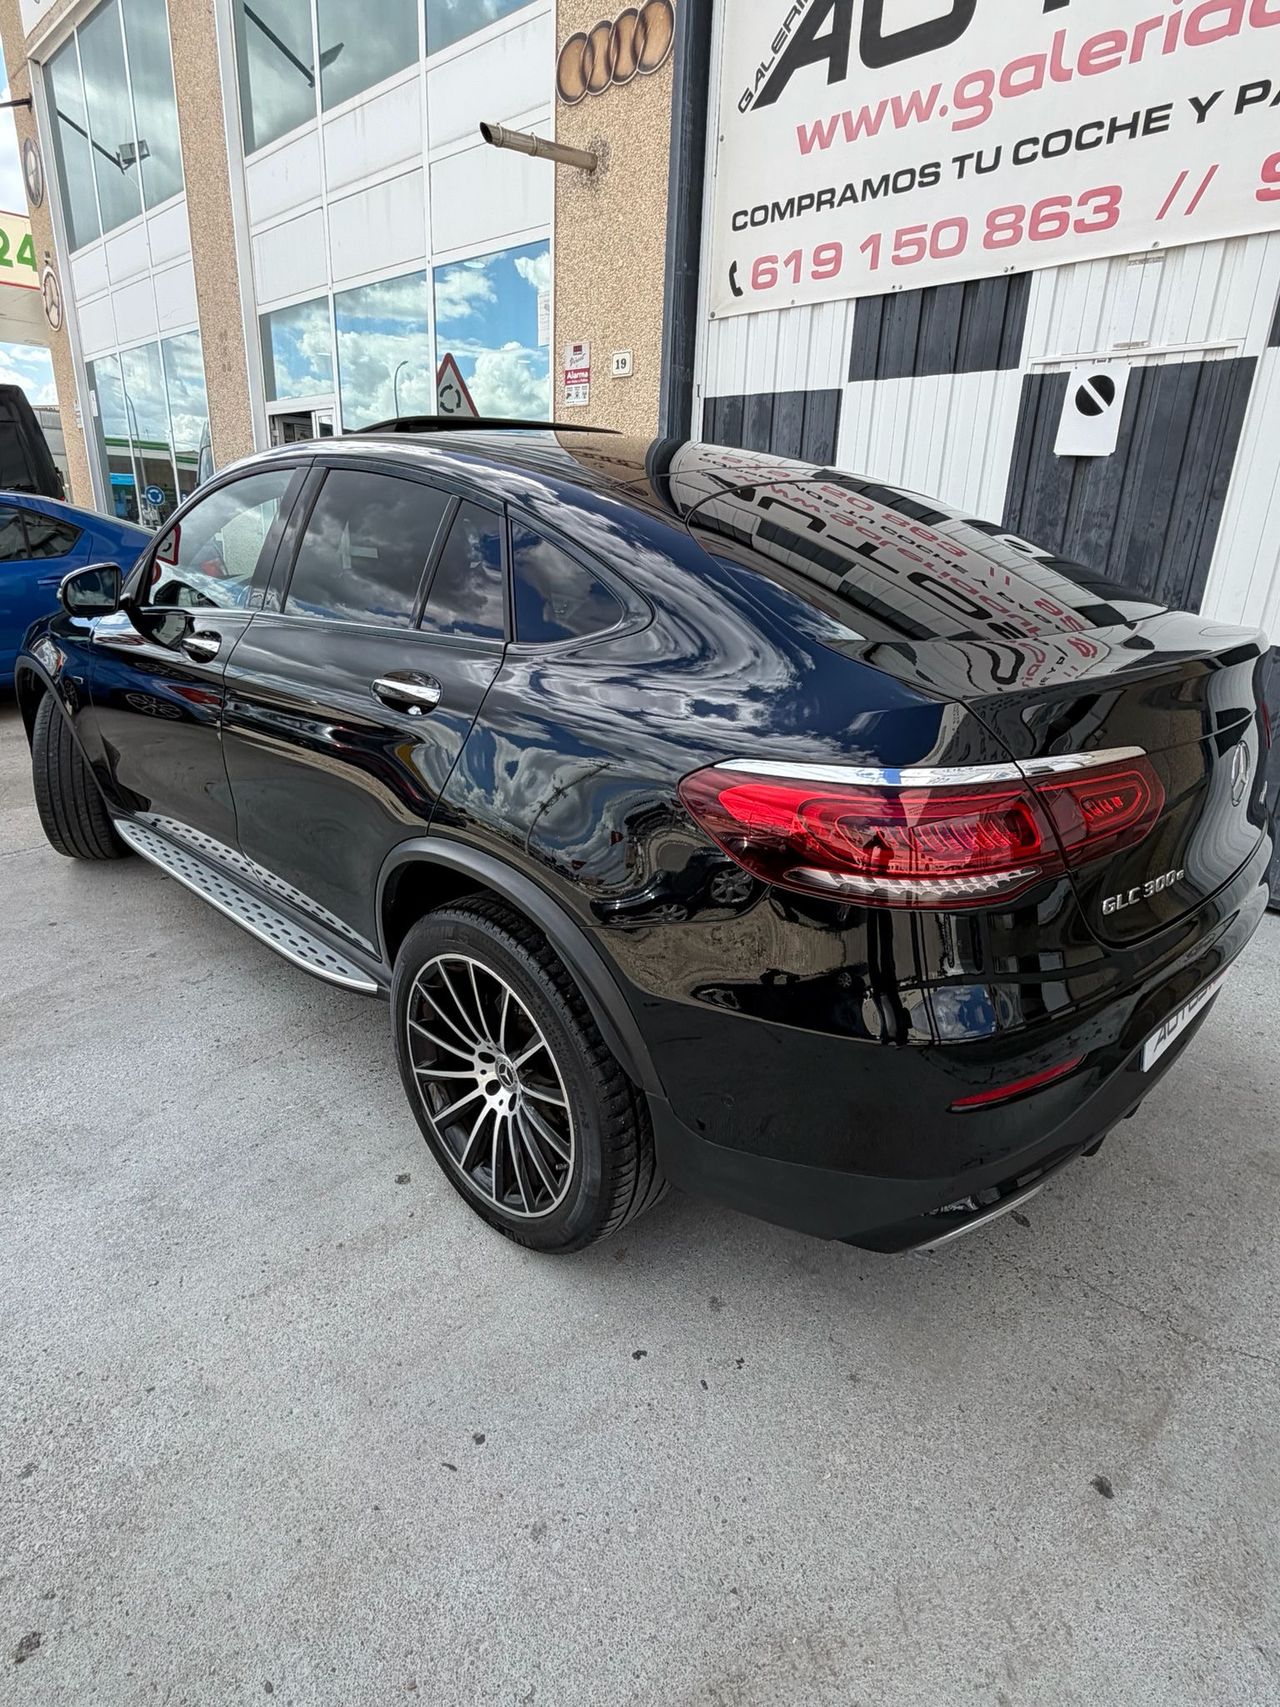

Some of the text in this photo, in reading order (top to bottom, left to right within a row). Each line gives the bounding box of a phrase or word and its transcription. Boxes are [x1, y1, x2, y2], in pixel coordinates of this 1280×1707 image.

[738, 0, 808, 114] GALERI
[731, 79, 1280, 232] COMPRAMOS TU COCHE Y P
[751, 241, 843, 291] 619
[859, 216, 969, 266] 150
[983, 185, 1122, 250] 863
[566, 370, 589, 380] Alarma
[615, 357, 627, 370] 19
[1102, 886, 1141, 916] GLC
